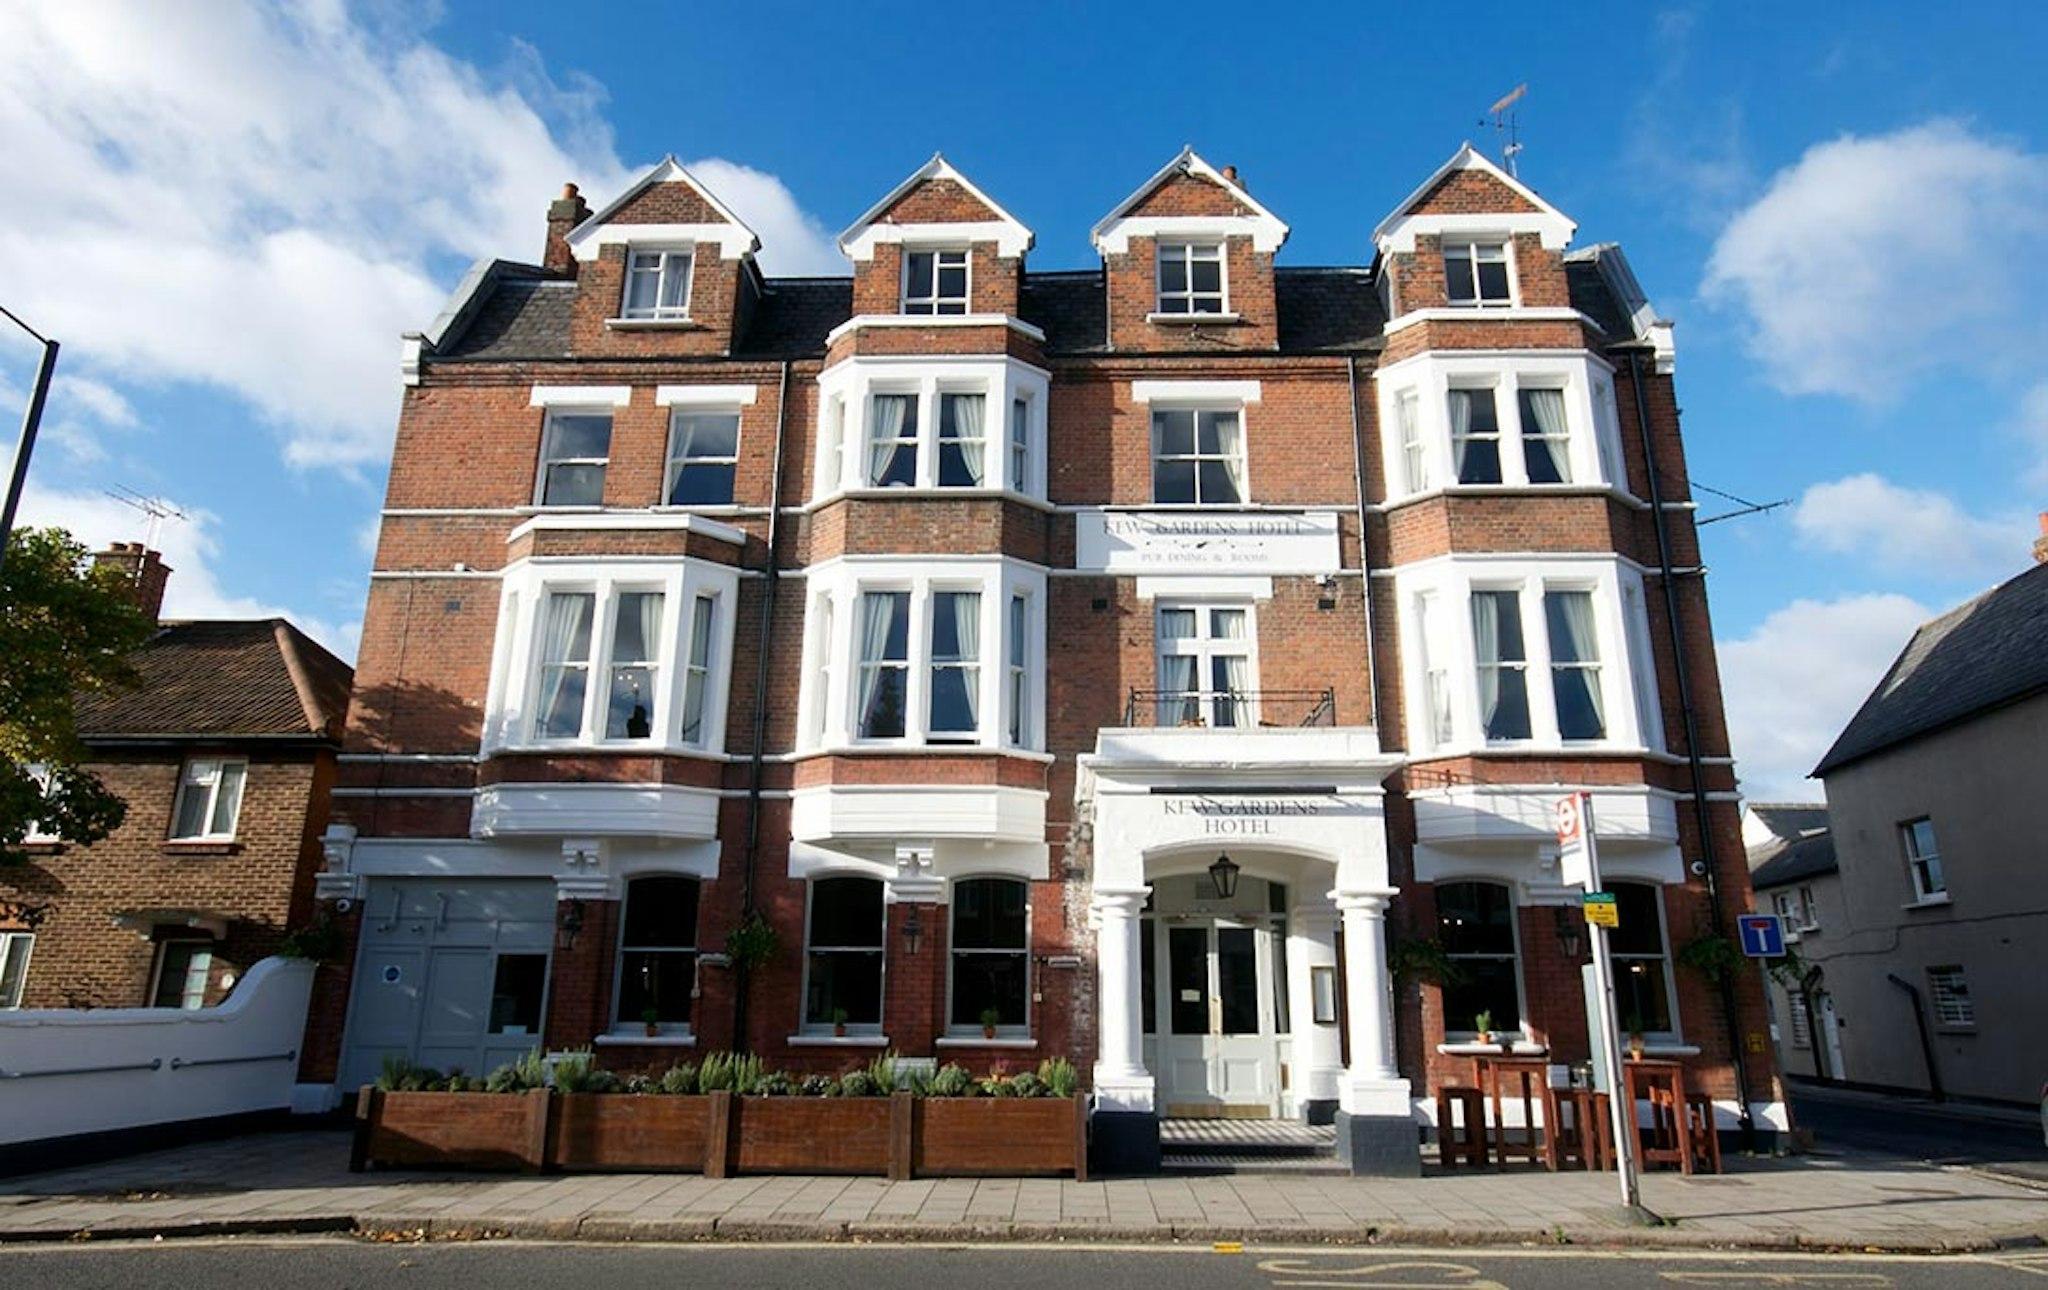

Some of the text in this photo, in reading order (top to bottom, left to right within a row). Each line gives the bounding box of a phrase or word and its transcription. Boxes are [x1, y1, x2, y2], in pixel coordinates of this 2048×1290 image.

[1155, 520, 1238, 534] GARDENS
[1248, 520, 1302, 534] HOTEL
[1164, 799, 1320, 815] KEW GARDENS
[1205, 818, 1277, 834] HOTEL
